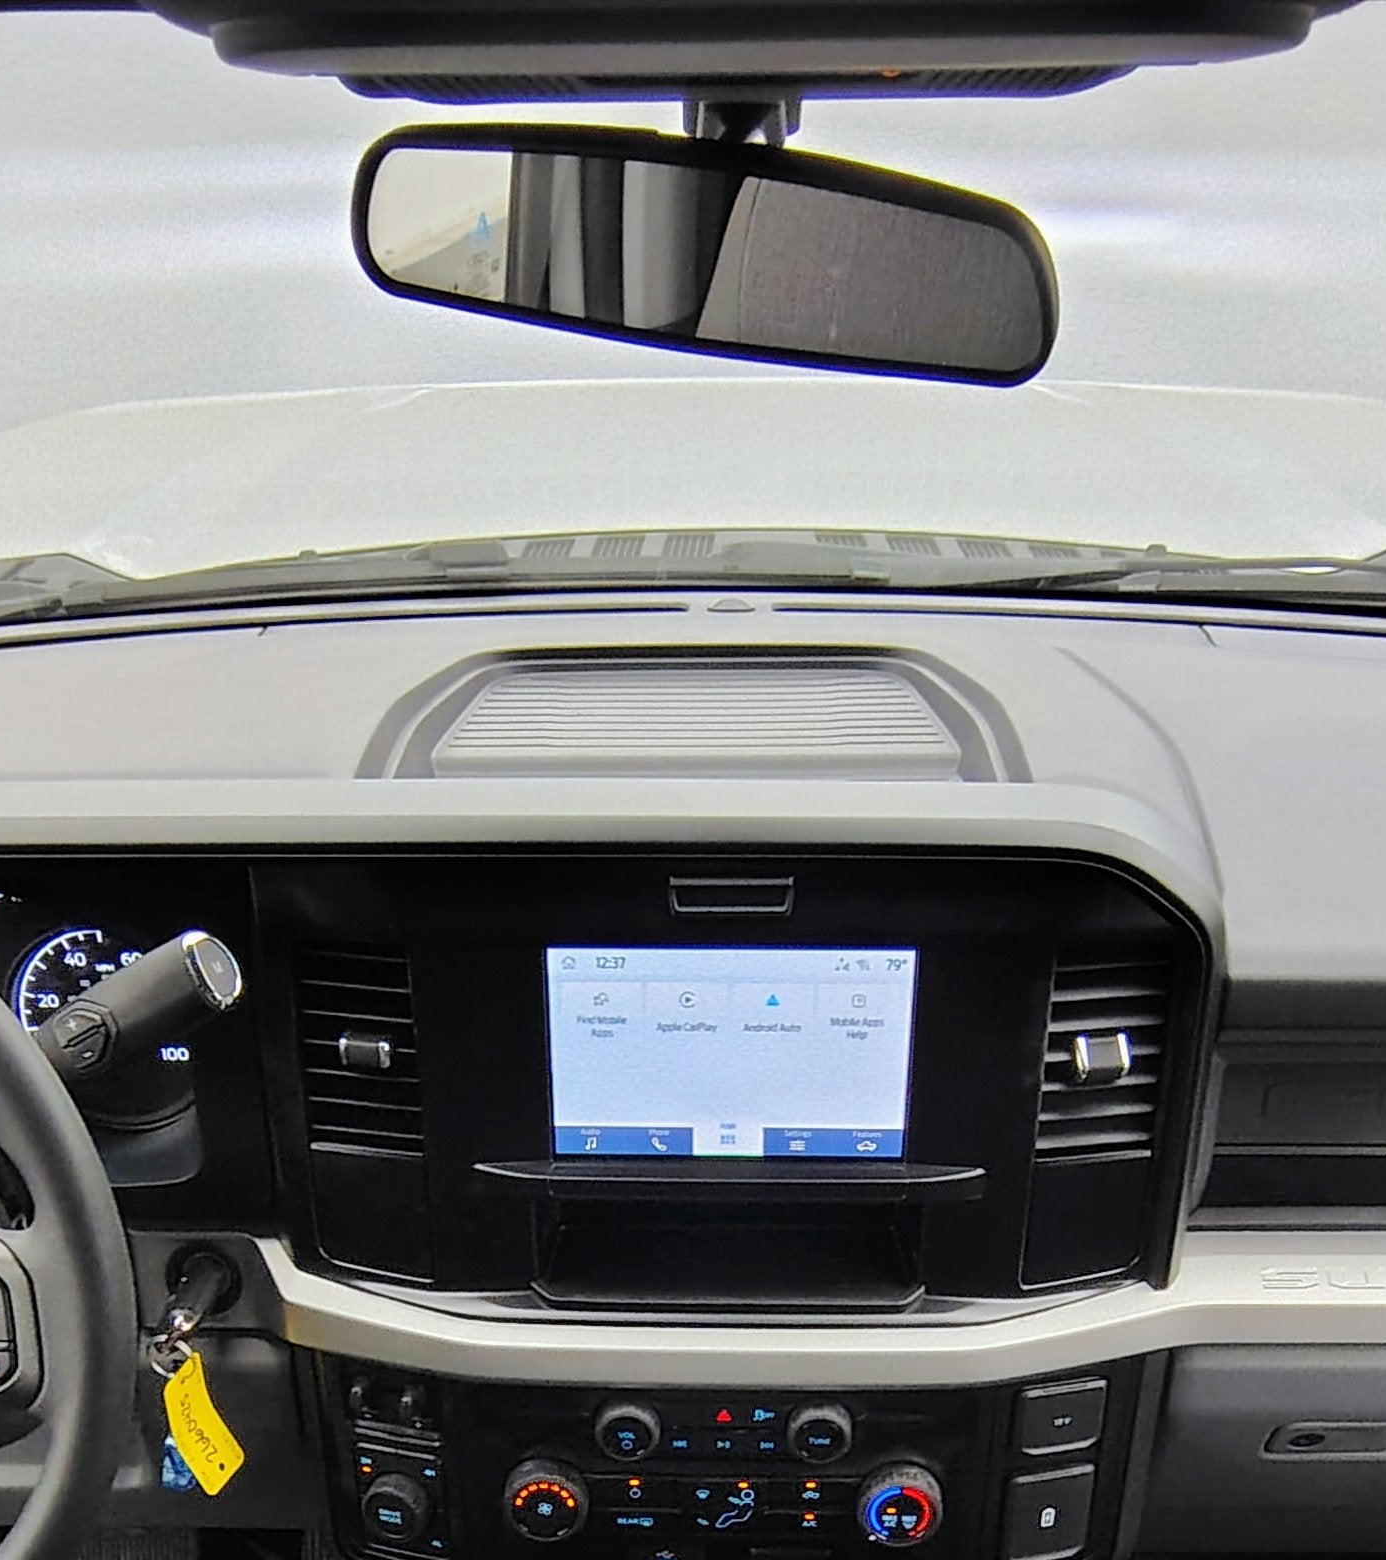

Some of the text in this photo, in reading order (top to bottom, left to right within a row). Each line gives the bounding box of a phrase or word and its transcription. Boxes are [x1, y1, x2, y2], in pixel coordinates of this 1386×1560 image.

[63, 952, 87, 967] 40
[595, 956, 626, 970] 12:37
[38, 995, 60, 1008] 20
[656, 1022, 718, 1033] Apple CarPlay
[743, 1022, 802, 1033] Android Auto
[160, 1047, 190, 1062] 100
[617, 1431, 636, 1440] VOL
